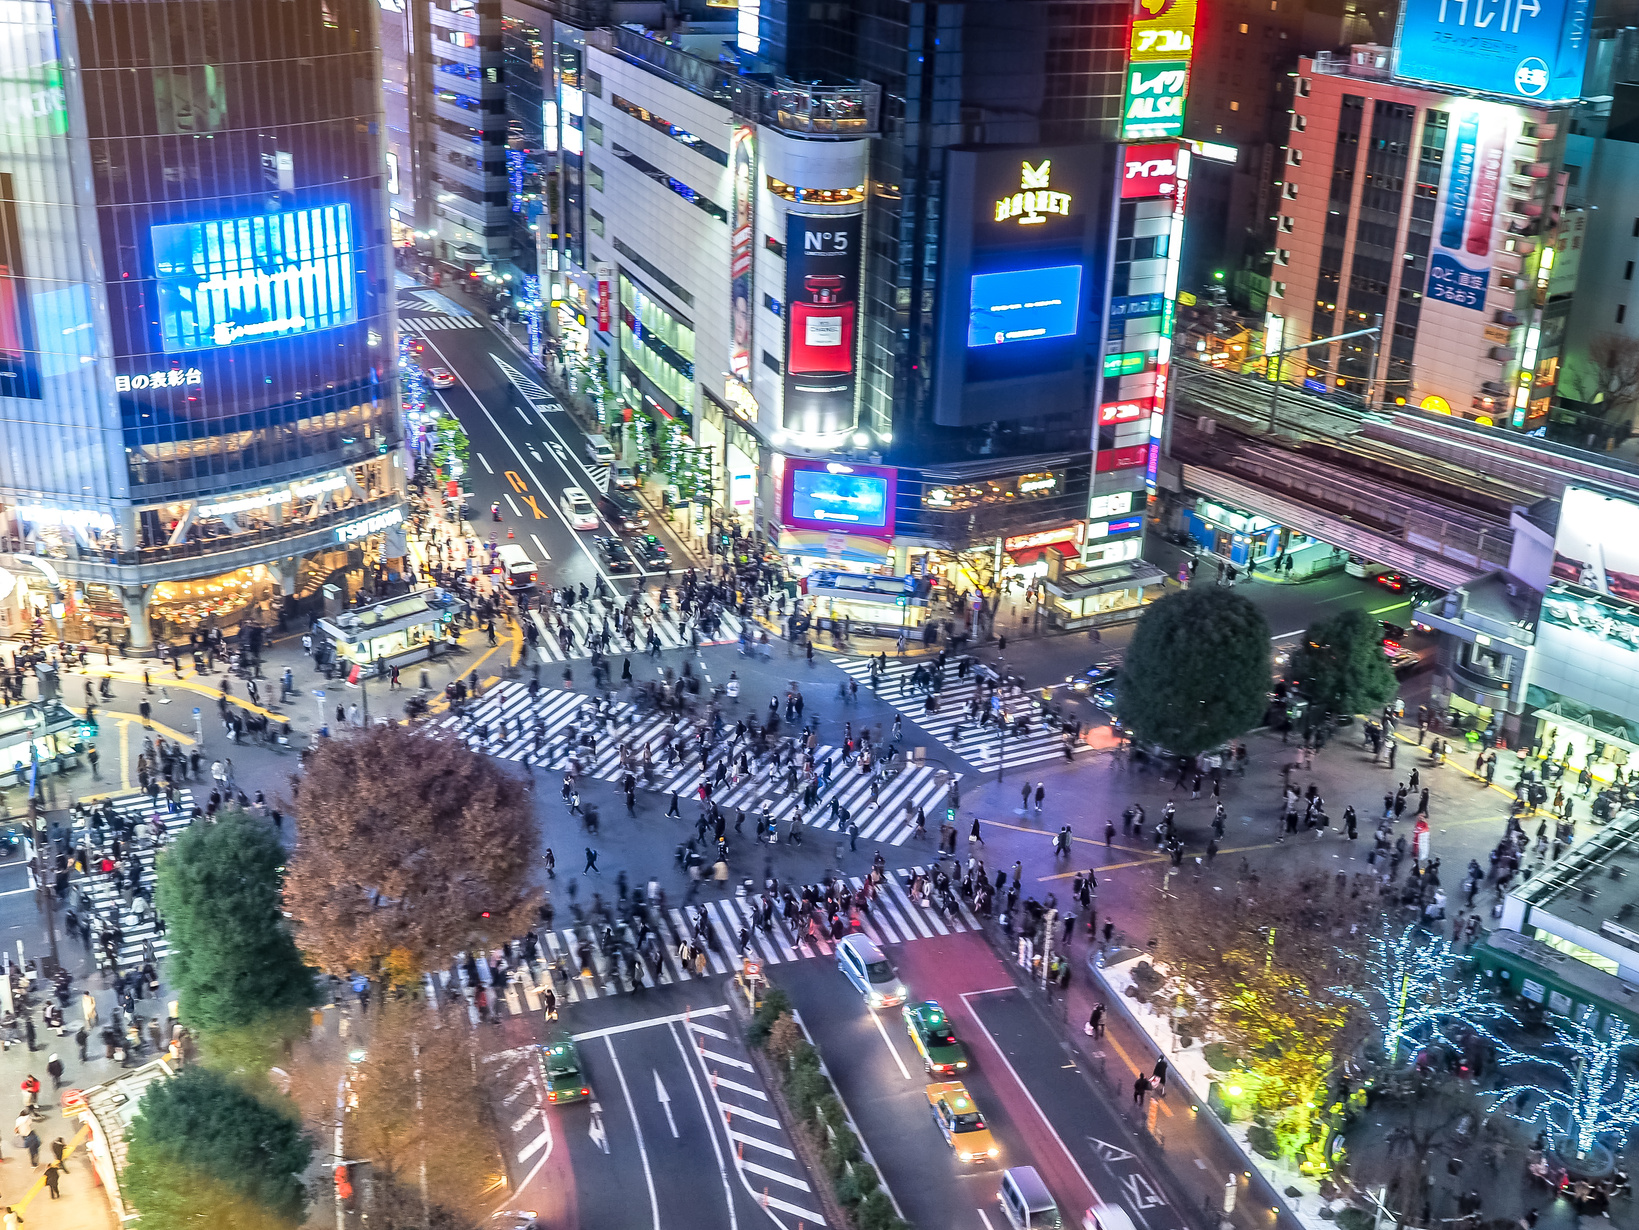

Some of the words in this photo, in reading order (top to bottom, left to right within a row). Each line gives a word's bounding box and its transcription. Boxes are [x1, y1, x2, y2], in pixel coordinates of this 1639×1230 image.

[1137, 30, 1192, 51] アコム
[1130, 70, 1186, 95] レイク
[1126, 96, 1182, 118] ALSA
[1434, 283, 1477, 305] うるおう
[115, 367, 202, 393] 目の表彰台
[335, 508, 403, 542] TSUTAYA
